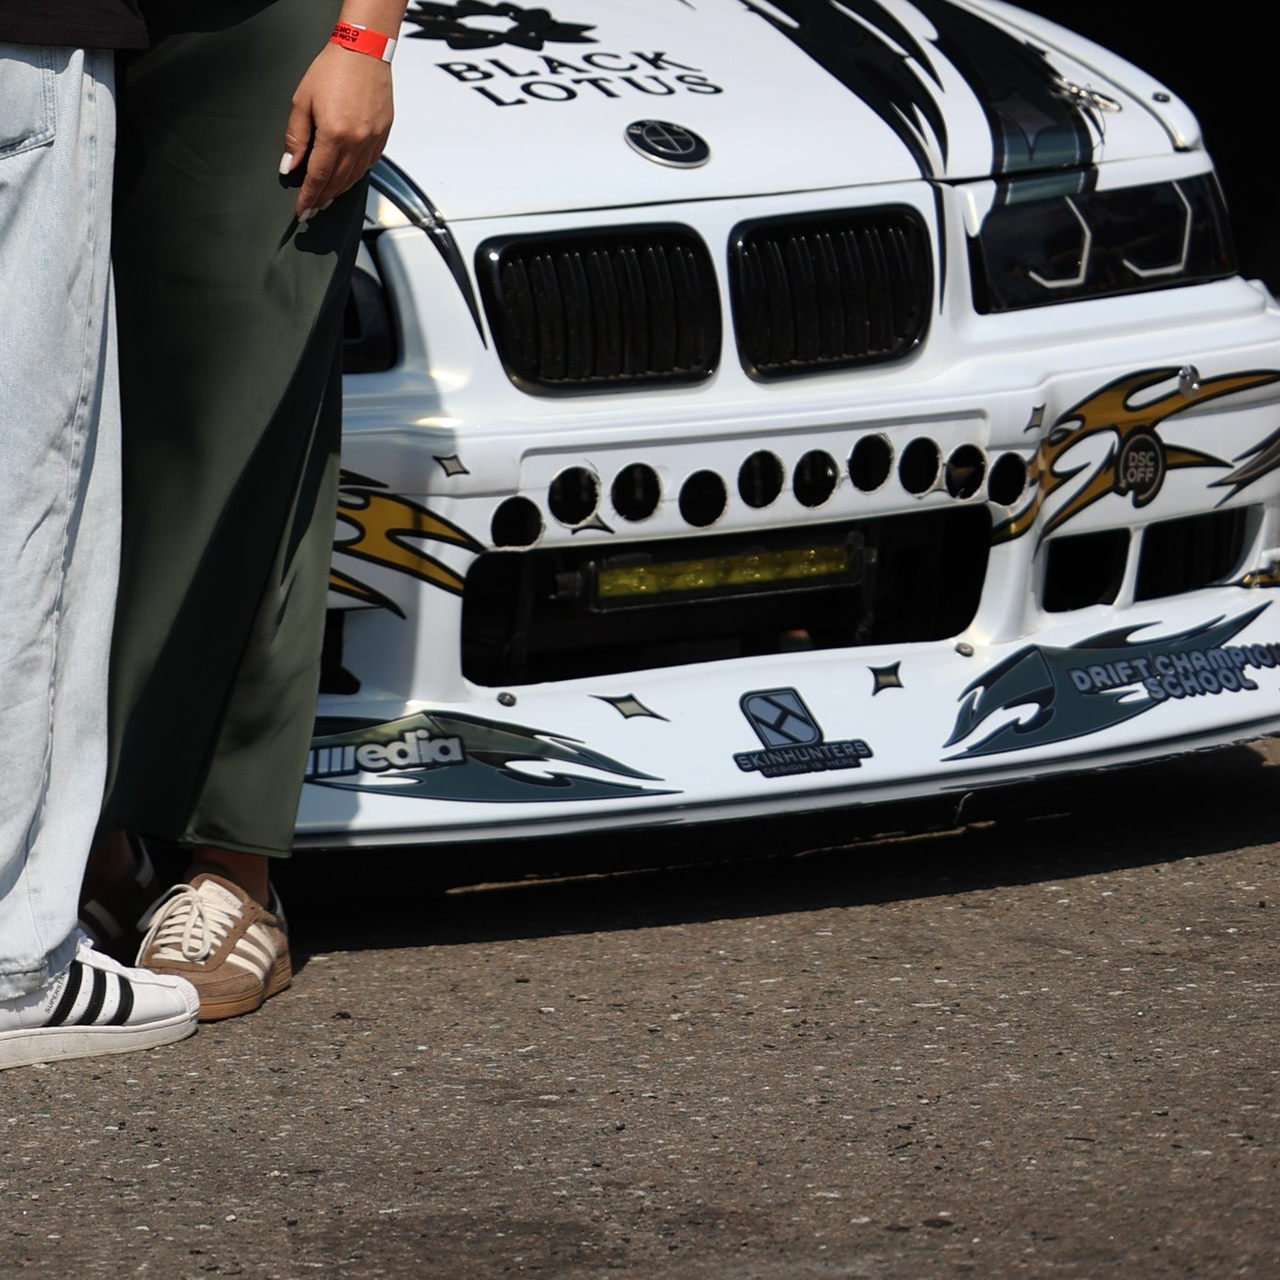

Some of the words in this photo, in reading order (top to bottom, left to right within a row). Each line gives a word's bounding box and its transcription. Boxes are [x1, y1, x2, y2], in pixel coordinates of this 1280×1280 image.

[434, 51, 703, 83] BLACK
[472, 74, 724, 107] LOTUS
[1128, 450, 1156, 467] DSC
[1126, 467, 1155, 483] OFF
[1070, 657, 1150, 692] DRIFT
[1144, 670, 1258, 701] SCHOOL
[737, 741, 870, 769] SKINHUNTERS
[764, 762, 807, 774] DESIGN
[809, 761, 824, 771] IS
[826, 757, 857, 767] HERE
